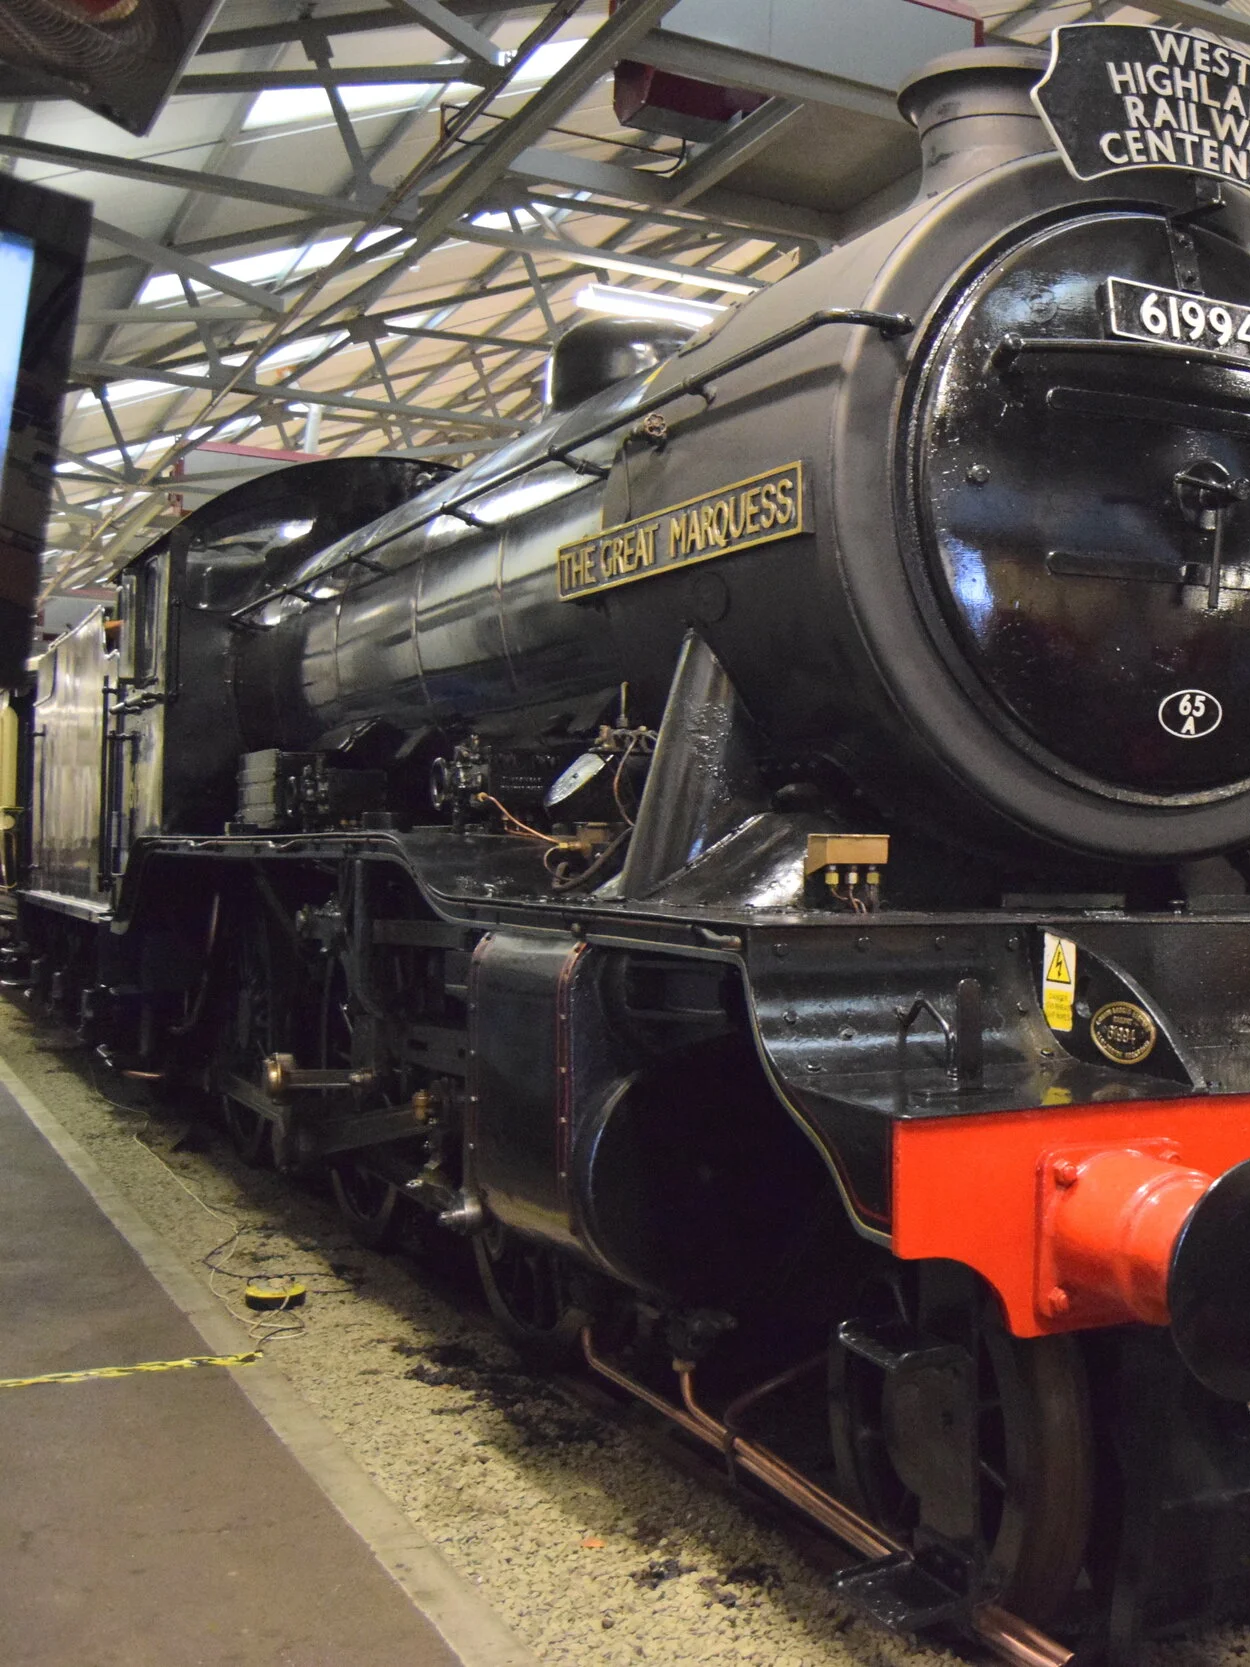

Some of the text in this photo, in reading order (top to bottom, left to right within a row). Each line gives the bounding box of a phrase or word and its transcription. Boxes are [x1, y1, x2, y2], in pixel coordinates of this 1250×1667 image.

[560, 478, 793, 590] THE GREAT MARQUESS
[1178, 693, 1206, 717] 65
[1180, 715, 1196, 735] A
